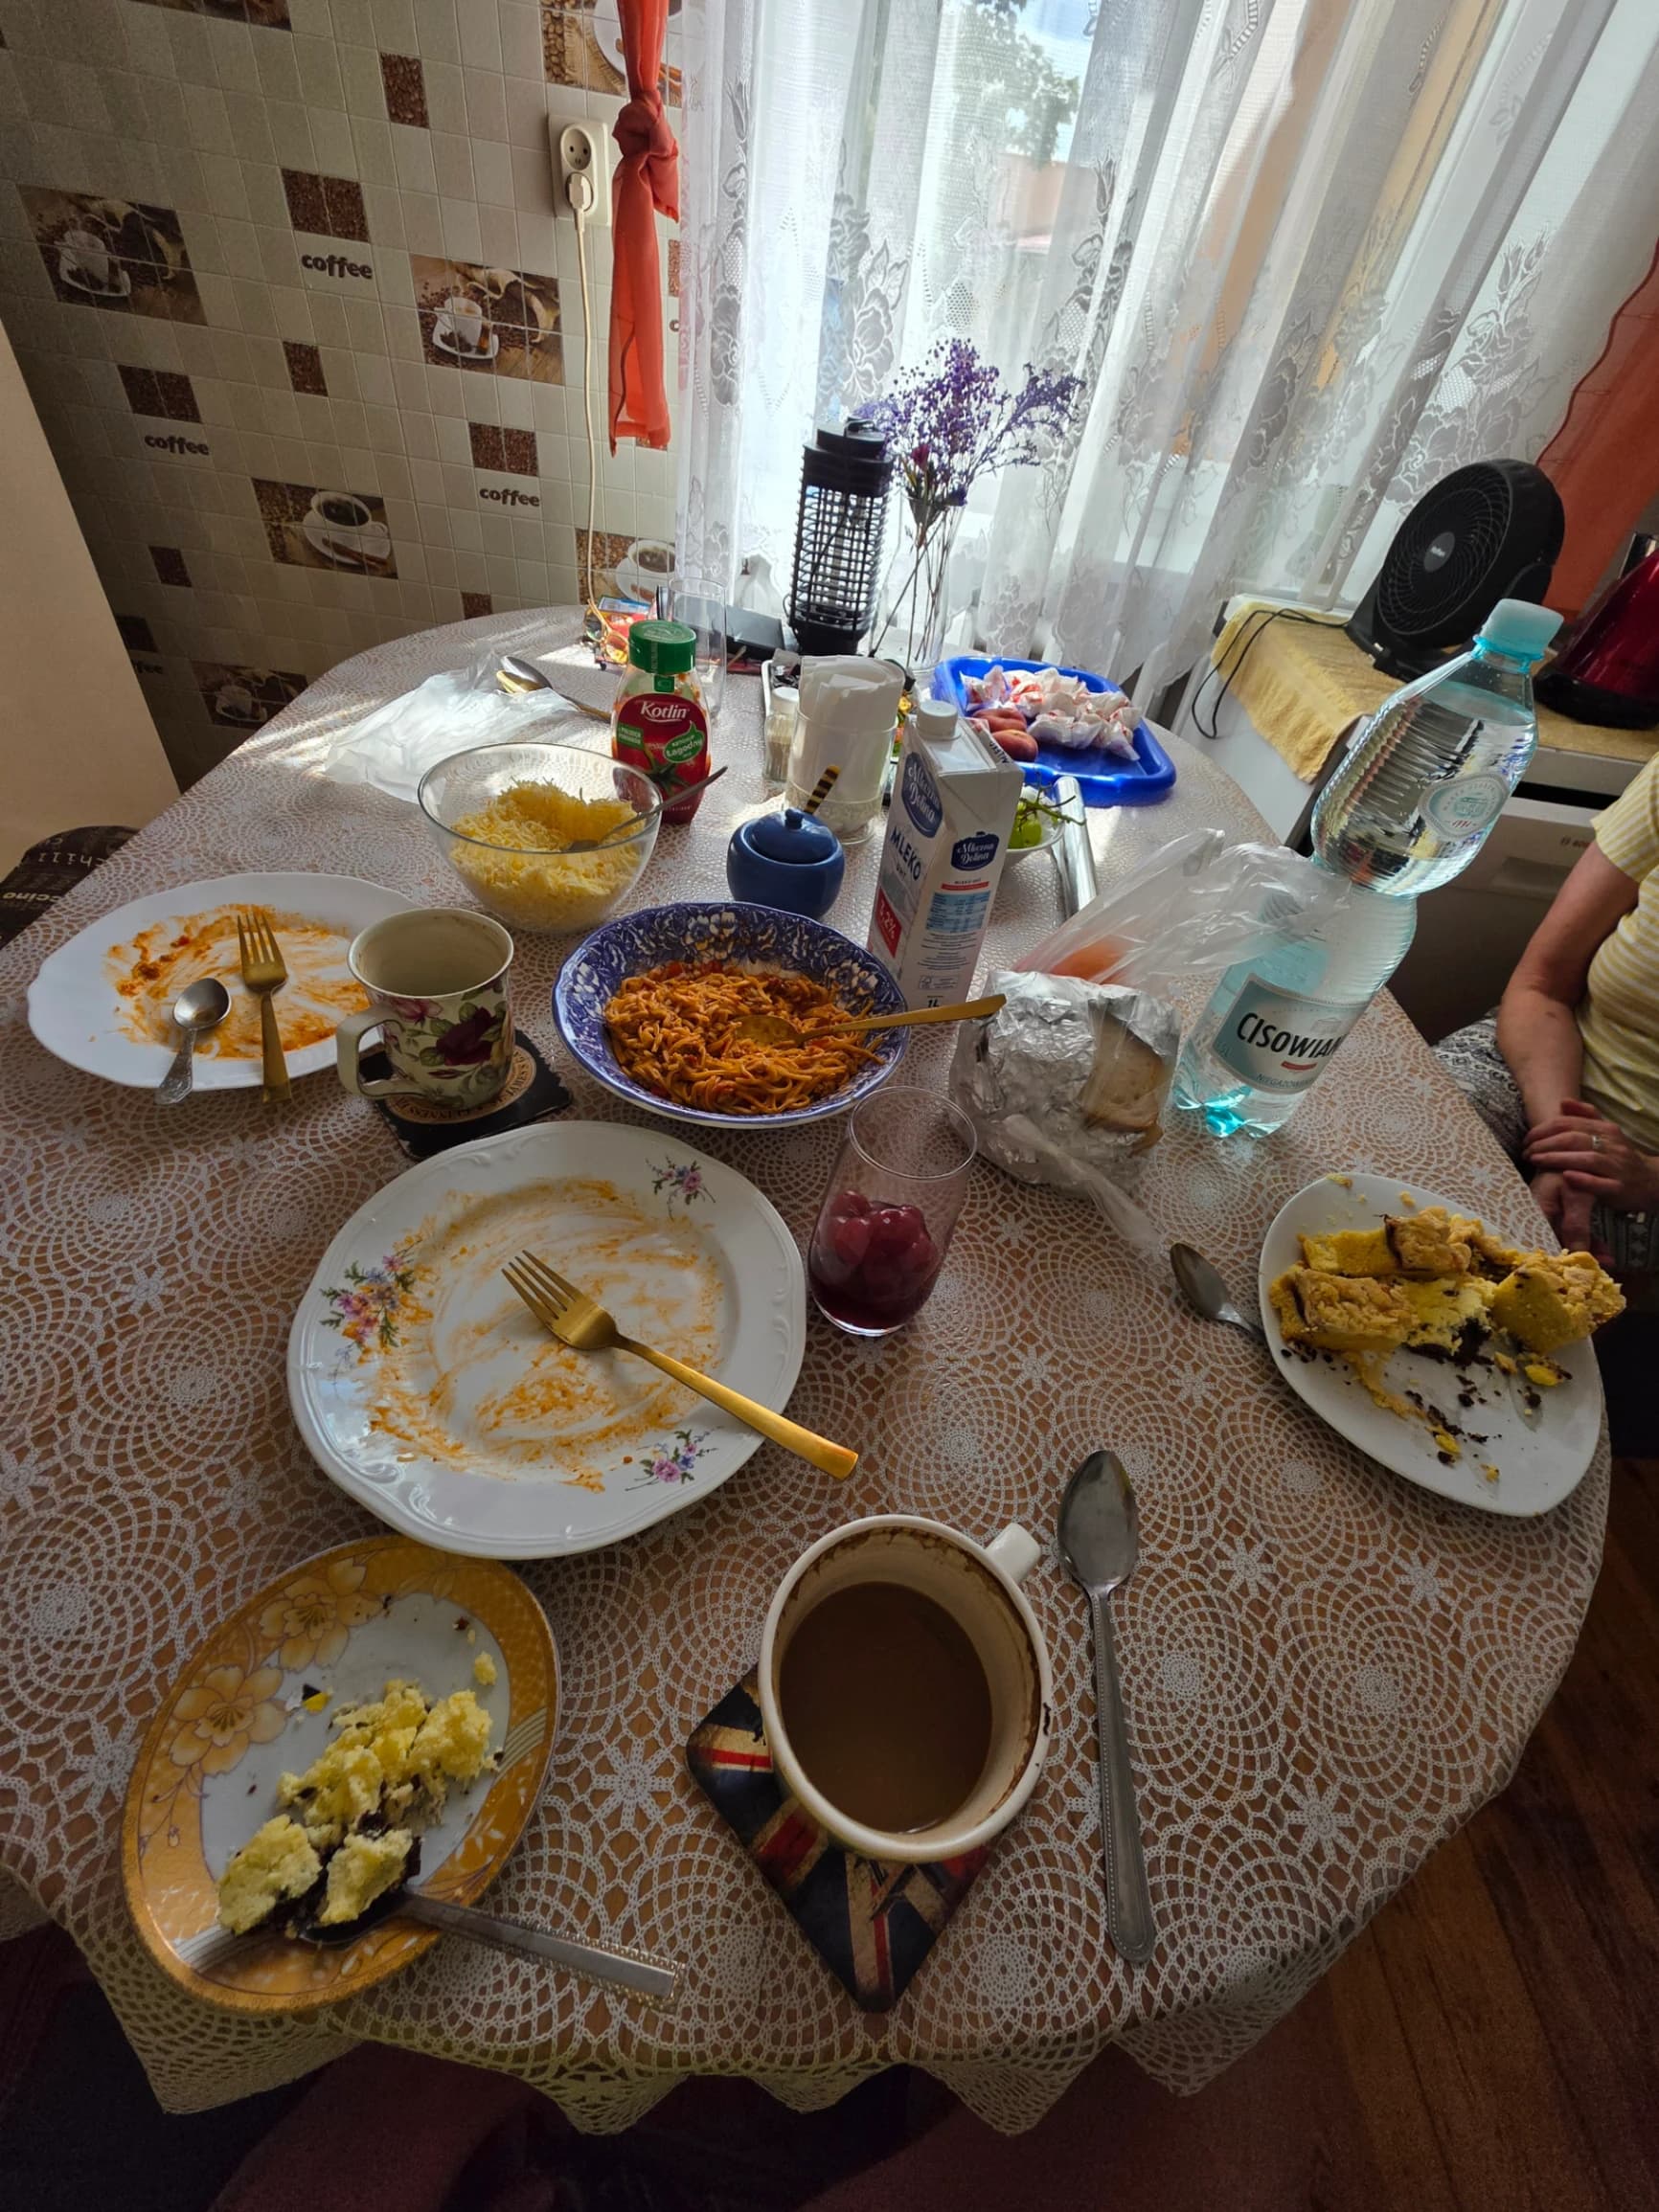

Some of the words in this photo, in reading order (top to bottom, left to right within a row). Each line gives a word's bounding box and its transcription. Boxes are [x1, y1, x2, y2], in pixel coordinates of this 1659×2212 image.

[301, 253, 374, 280] coffee
[145, 434, 210, 456] coffee
[479, 488, 540, 507] coffee
[640, 701, 687, 719] Kotlin
[890, 825, 921, 881] MLEKO
